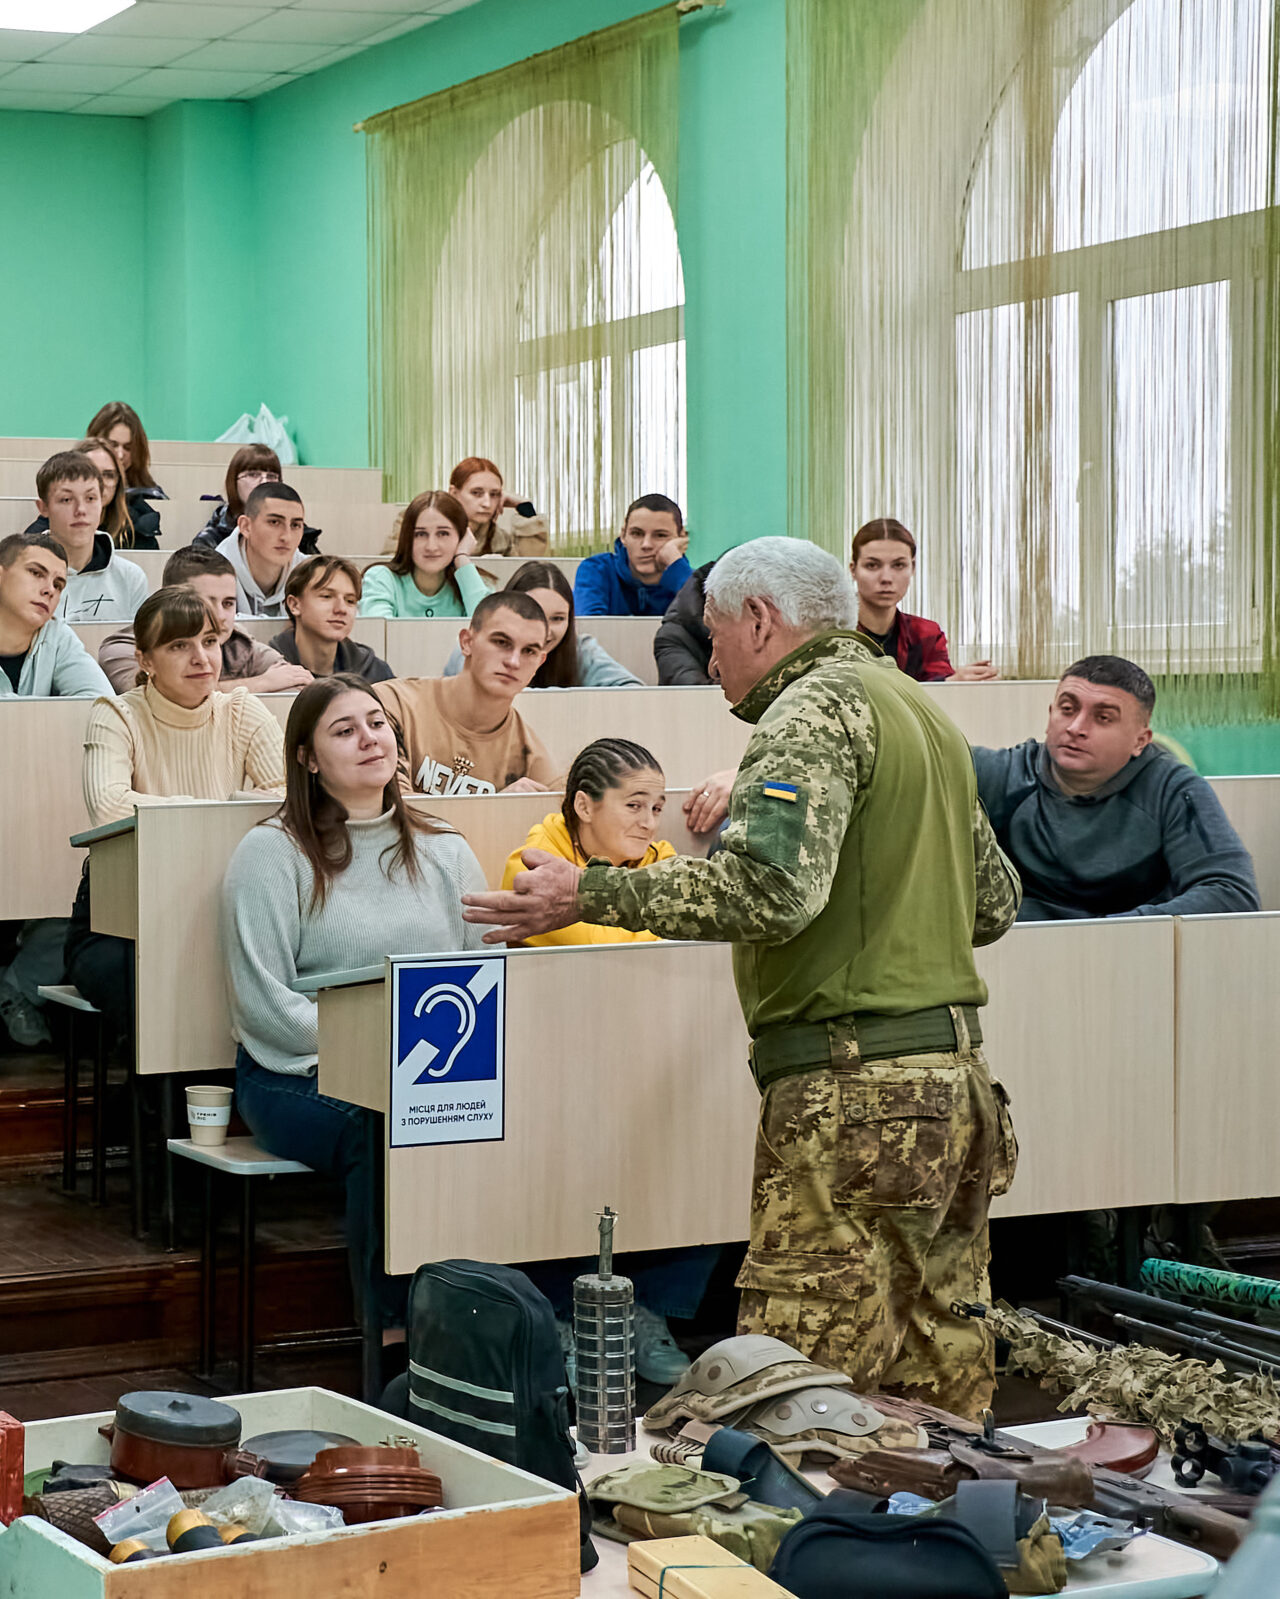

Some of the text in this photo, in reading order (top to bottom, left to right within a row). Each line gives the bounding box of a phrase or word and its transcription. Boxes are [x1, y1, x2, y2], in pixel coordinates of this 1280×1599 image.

[409, 1100, 486, 1114] МІСЦЯ ДЛЯ ЛЮДЕЙ
[401, 1112, 494, 1126] З ПОРУШЕННЯМ СЛУХУ
